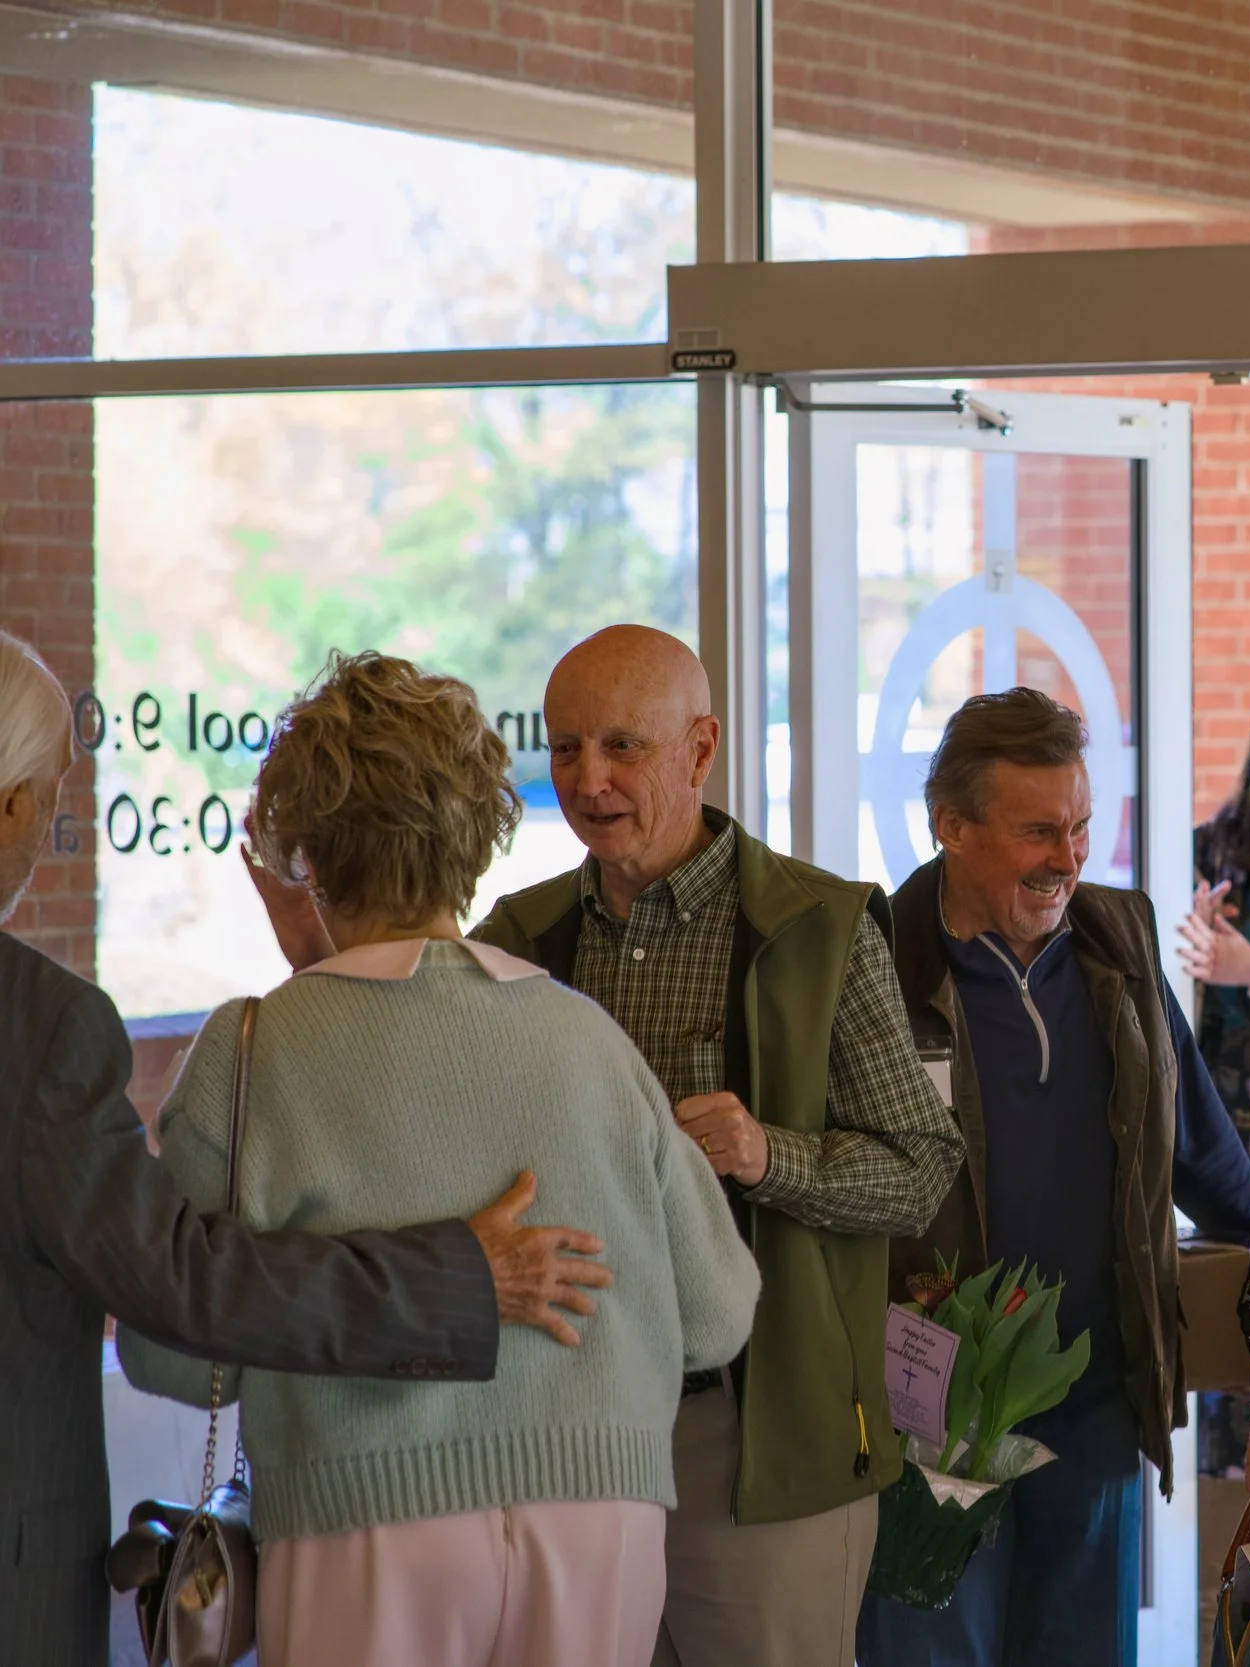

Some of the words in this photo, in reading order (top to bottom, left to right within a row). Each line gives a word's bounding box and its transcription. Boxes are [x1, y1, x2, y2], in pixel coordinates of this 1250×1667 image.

[676, 354, 731, 368] STANLEY
[901, 1324, 921, 1342] Happy
[902, 1350, 922, 1366] Baptist
[921, 1359, 940, 1377] Family
